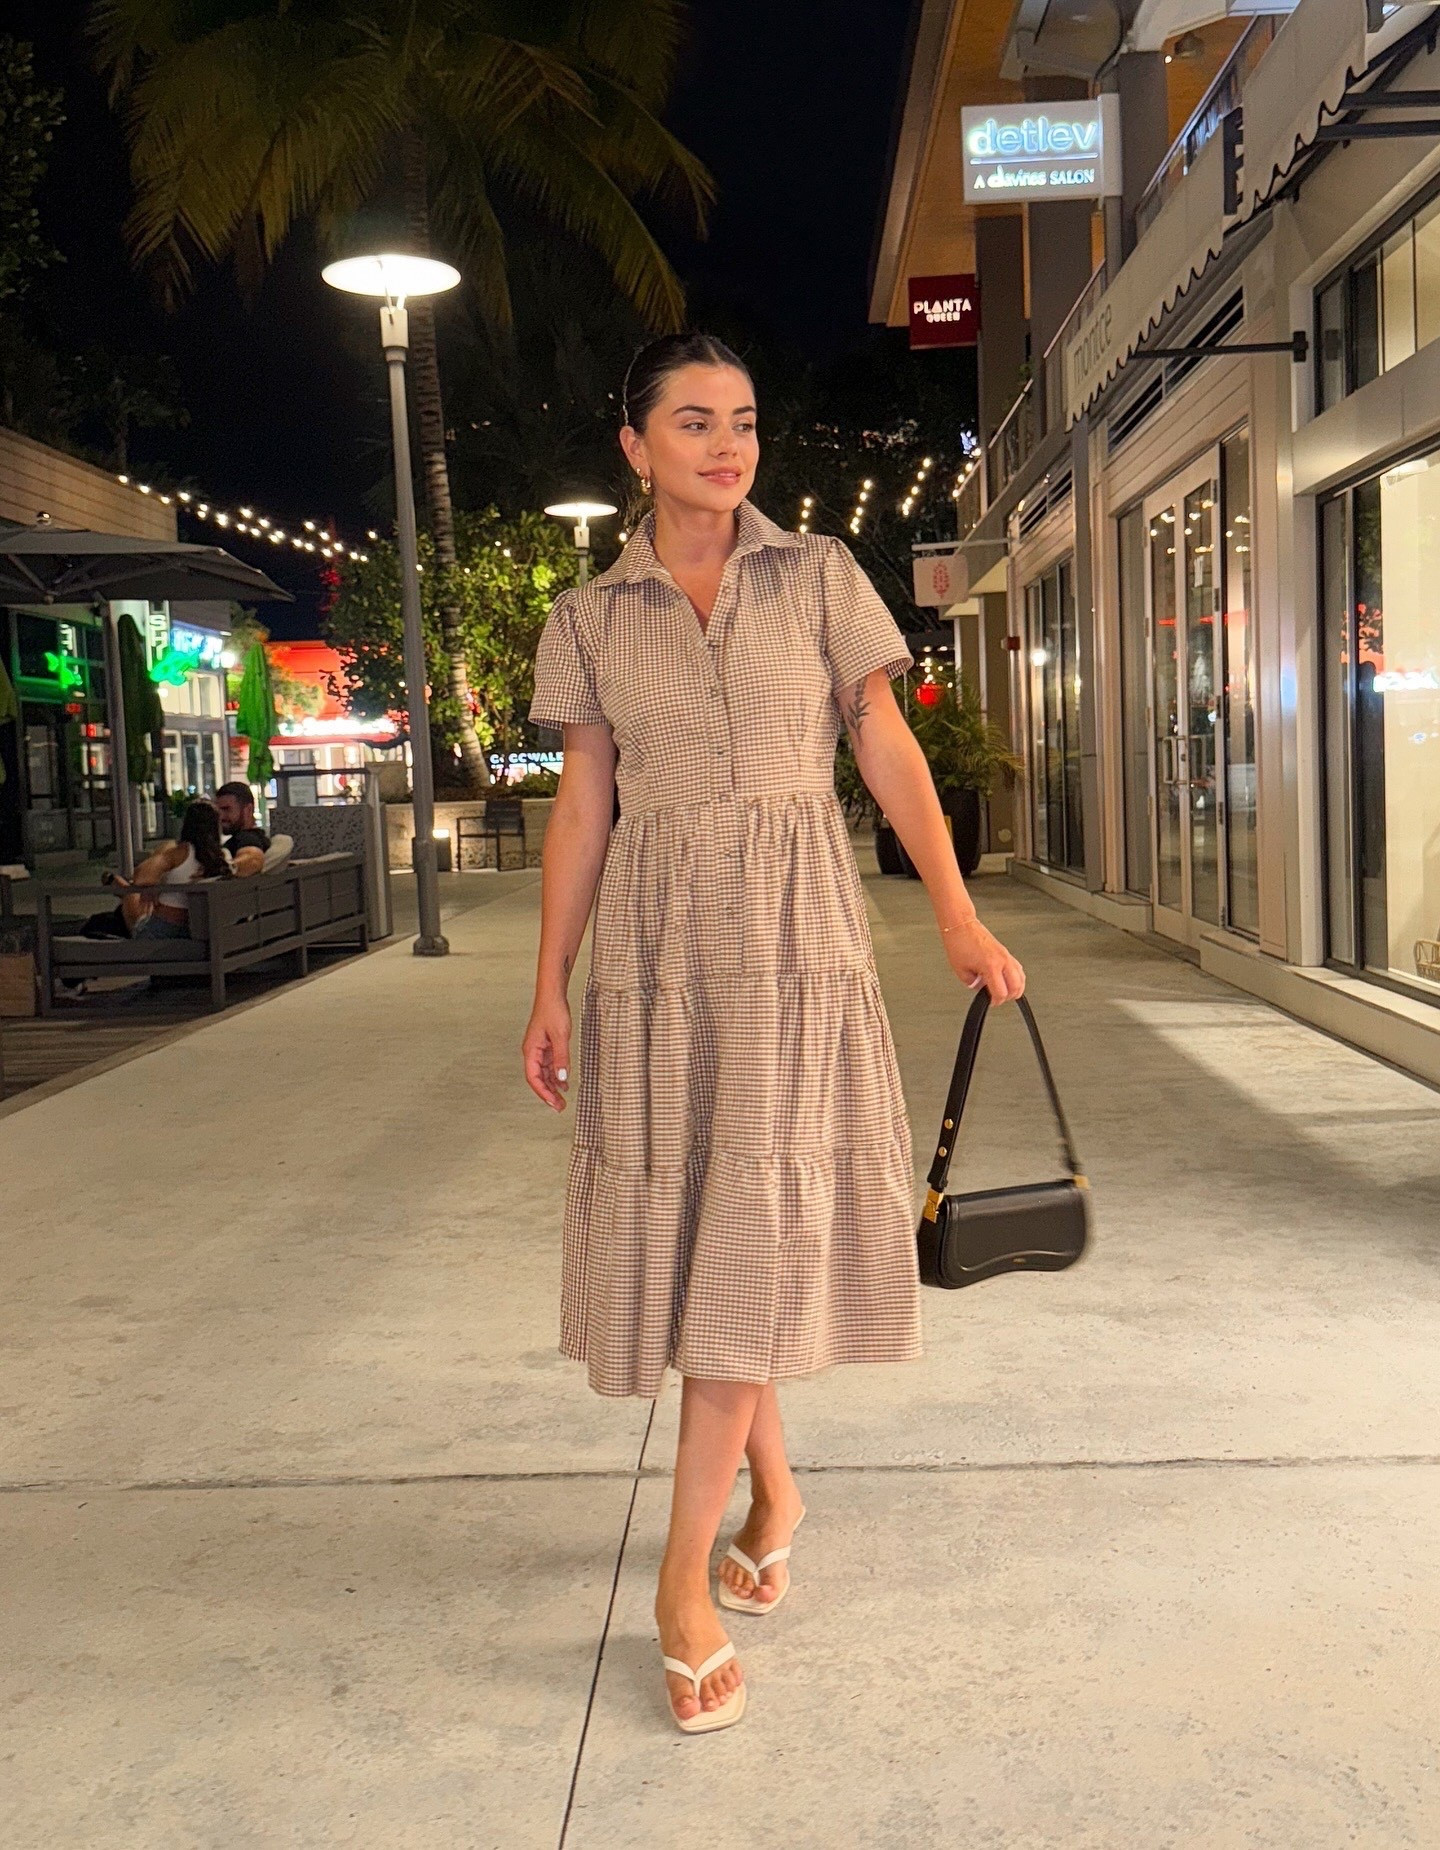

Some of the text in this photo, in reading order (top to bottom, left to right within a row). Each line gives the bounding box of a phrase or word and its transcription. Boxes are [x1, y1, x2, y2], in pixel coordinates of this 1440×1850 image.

[969, 116, 1098, 154] detlev
[973, 174, 986, 190] A
[1049, 168, 1096, 186] SALON
[913, 298, 972, 315] PLANTA
[926, 311, 961, 323] QUEEN
